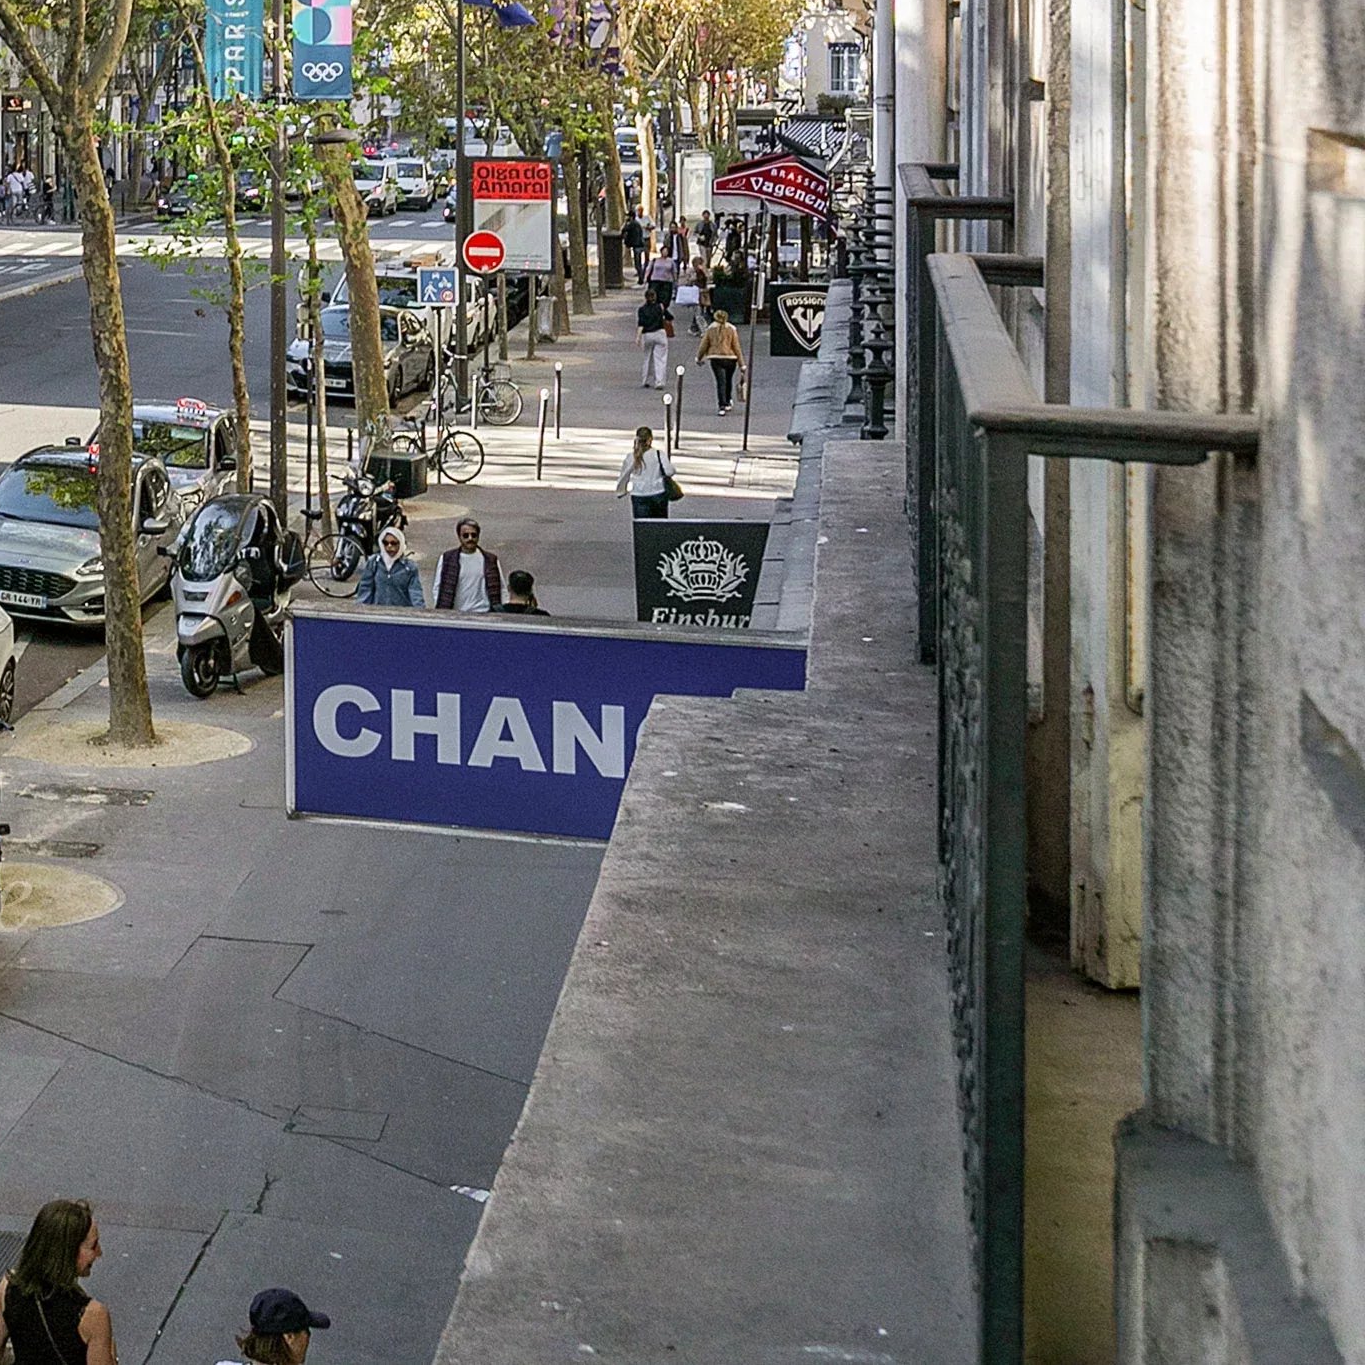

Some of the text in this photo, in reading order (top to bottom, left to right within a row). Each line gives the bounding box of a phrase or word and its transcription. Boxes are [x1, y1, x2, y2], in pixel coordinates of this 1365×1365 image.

[477, 166, 549, 180] Olga de
[477, 180, 549, 193] Amaral
[312, 684, 643, 778] CHAN
